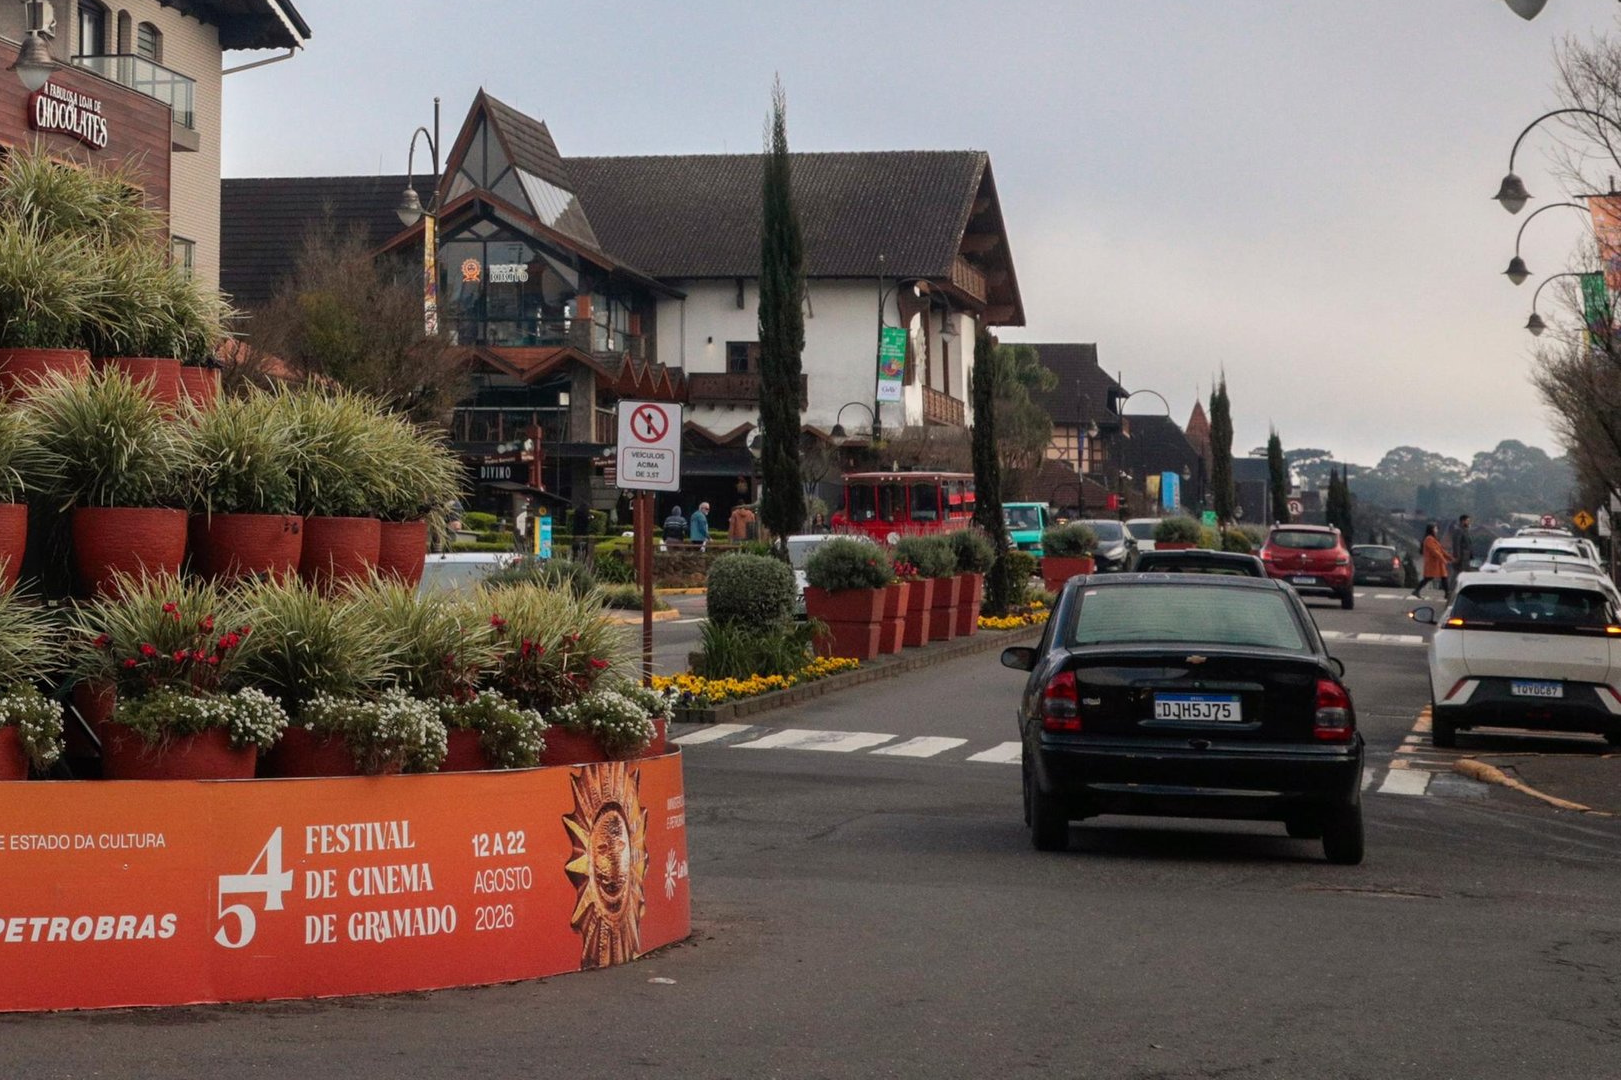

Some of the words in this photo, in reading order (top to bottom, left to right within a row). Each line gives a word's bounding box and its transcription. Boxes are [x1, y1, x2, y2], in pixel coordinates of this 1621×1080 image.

[44, 81, 48, 94] A
[50, 83, 78, 106] FABULOSA
[79, 94, 93, 111] LOJA
[94, 100, 101, 113] DE
[36, 95, 108, 147] CHOCOLATES
[481, 466, 511, 479] DIVINO
[1163, 702, 1231, 719] DJH5J75
[10, 834, 70, 850] ESTADO
[75, 834, 95, 849] DA
[99, 833, 166, 849] CULTURA
[305, 821, 415, 854] FESTIVAL
[472, 833, 490, 857] 12
[493, 832, 504, 856] A
[507, 830, 526, 854] 22
[305, 869, 337, 899] DE
[348, 863, 434, 897] CINEMA
[474, 866, 532, 894] AGOSTO
[305, 914, 337, 945] DE
[348, 905, 457, 944] GRAMADO
[475, 904, 514, 931] 2026
